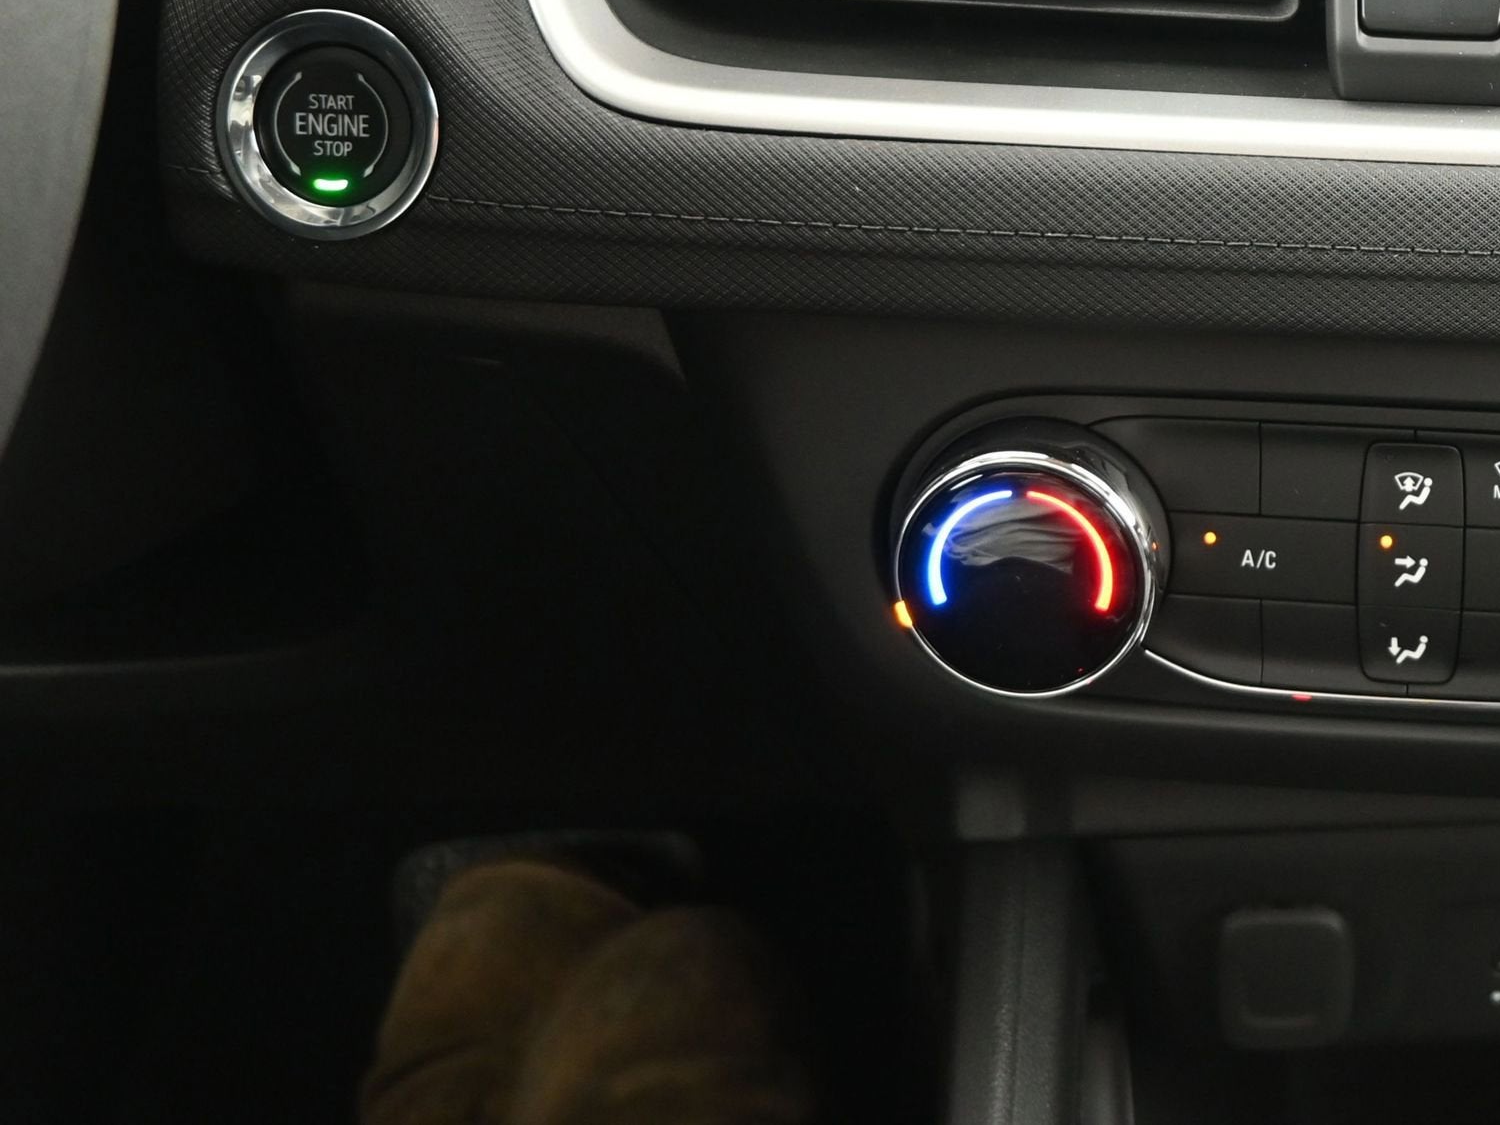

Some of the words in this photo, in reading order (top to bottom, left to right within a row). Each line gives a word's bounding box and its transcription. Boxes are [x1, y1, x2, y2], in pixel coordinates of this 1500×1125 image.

[309, 94, 355, 110] START
[295, 112, 370, 138] ENGINE
[313, 140, 353, 157] STOP
[1242, 550, 1277, 570] A/C
